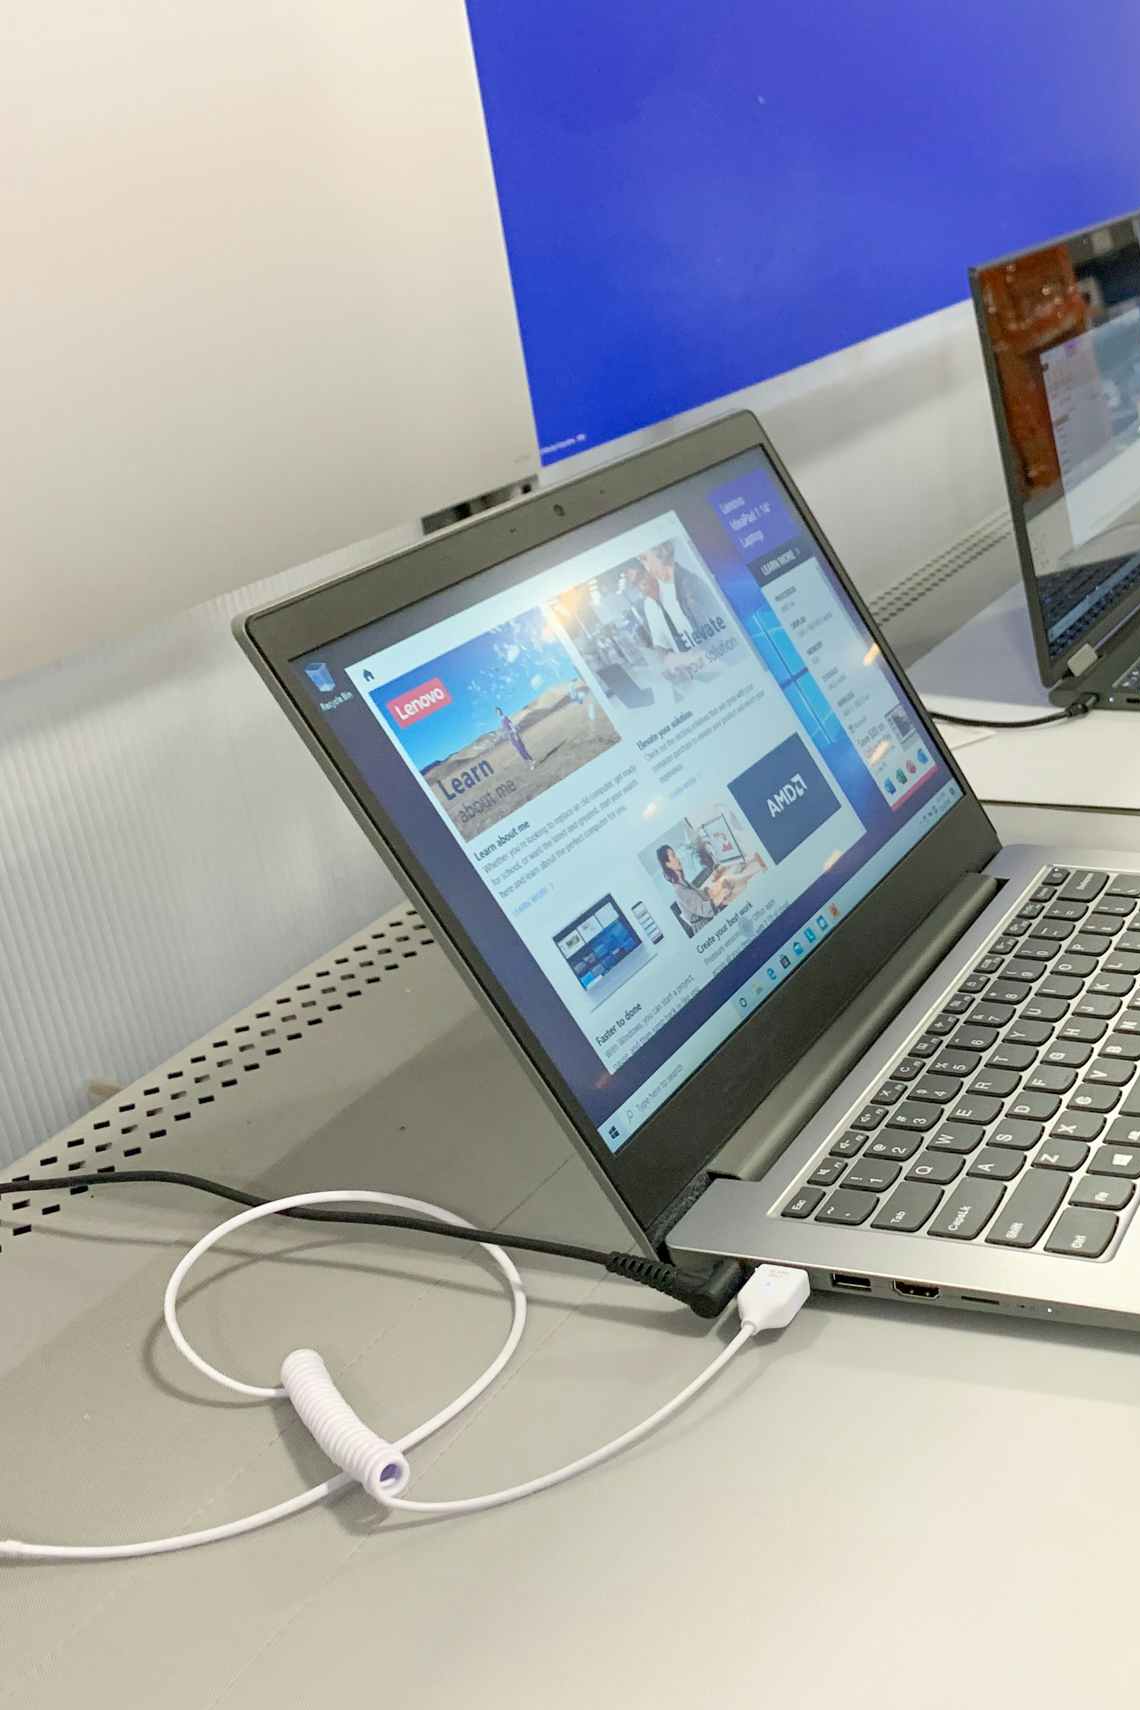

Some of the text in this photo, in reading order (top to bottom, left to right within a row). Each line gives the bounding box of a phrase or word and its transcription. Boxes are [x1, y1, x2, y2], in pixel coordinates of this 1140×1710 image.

[759, 557, 781, 577] LEARN
[677, 614, 727, 652] Elevate
[394, 687, 445, 721] Lenovo
[438, 758, 493, 802] Learn
[458, 779, 518, 824] about me
[763, 780, 798, 818] AMD
[472, 819, 531, 862] Learn about me
[695, 934, 717, 955] Create
[714, 922, 728, 941] your
[726, 911, 740, 928] best
[738, 900, 753, 917] work
[1092, 982, 1111, 990] K
[1025, 1007, 1044, 1015] U
[594, 1024, 618, 1047] Faster
[615, 1017, 626, 1029] to
[622, 1002, 642, 1022] done
[1119, 1020, 1138, 1029] N
[1009, 1030, 1027, 1038] Y
[1063, 1027, 1082, 1036] H
[1104, 1044, 1124, 1053] B
[992, 1055, 1011, 1063] T
[1047, 1051, 1067, 1060] G
[1089, 1069, 1109, 1079] V
[973, 1080, 993, 1089] R
[1030, 1078, 1049, 1086] F
[1073, 1095, 1095, 1105] C
[954, 1108, 974, 1116] E
[1013, 1104, 1032, 1113] D
[1056, 1123, 1078, 1133] X
[934, 1133, 956, 1145] W
[994, 1132, 1014, 1141] S
[890, 1146, 908, 1154] 2
[1039, 1153, 1060, 1163] Z
[912, 1164, 935, 1175] Q
[974, 1161, 996, 1172] A
[791, 1199, 807, 1210] Esc
[889, 1209, 907, 1224] Tab
[945, 1204, 970, 1230] CapsLk
[1003, 1221, 1026, 1239] Shift
[1069, 1234, 1088, 1249] Ctrl
